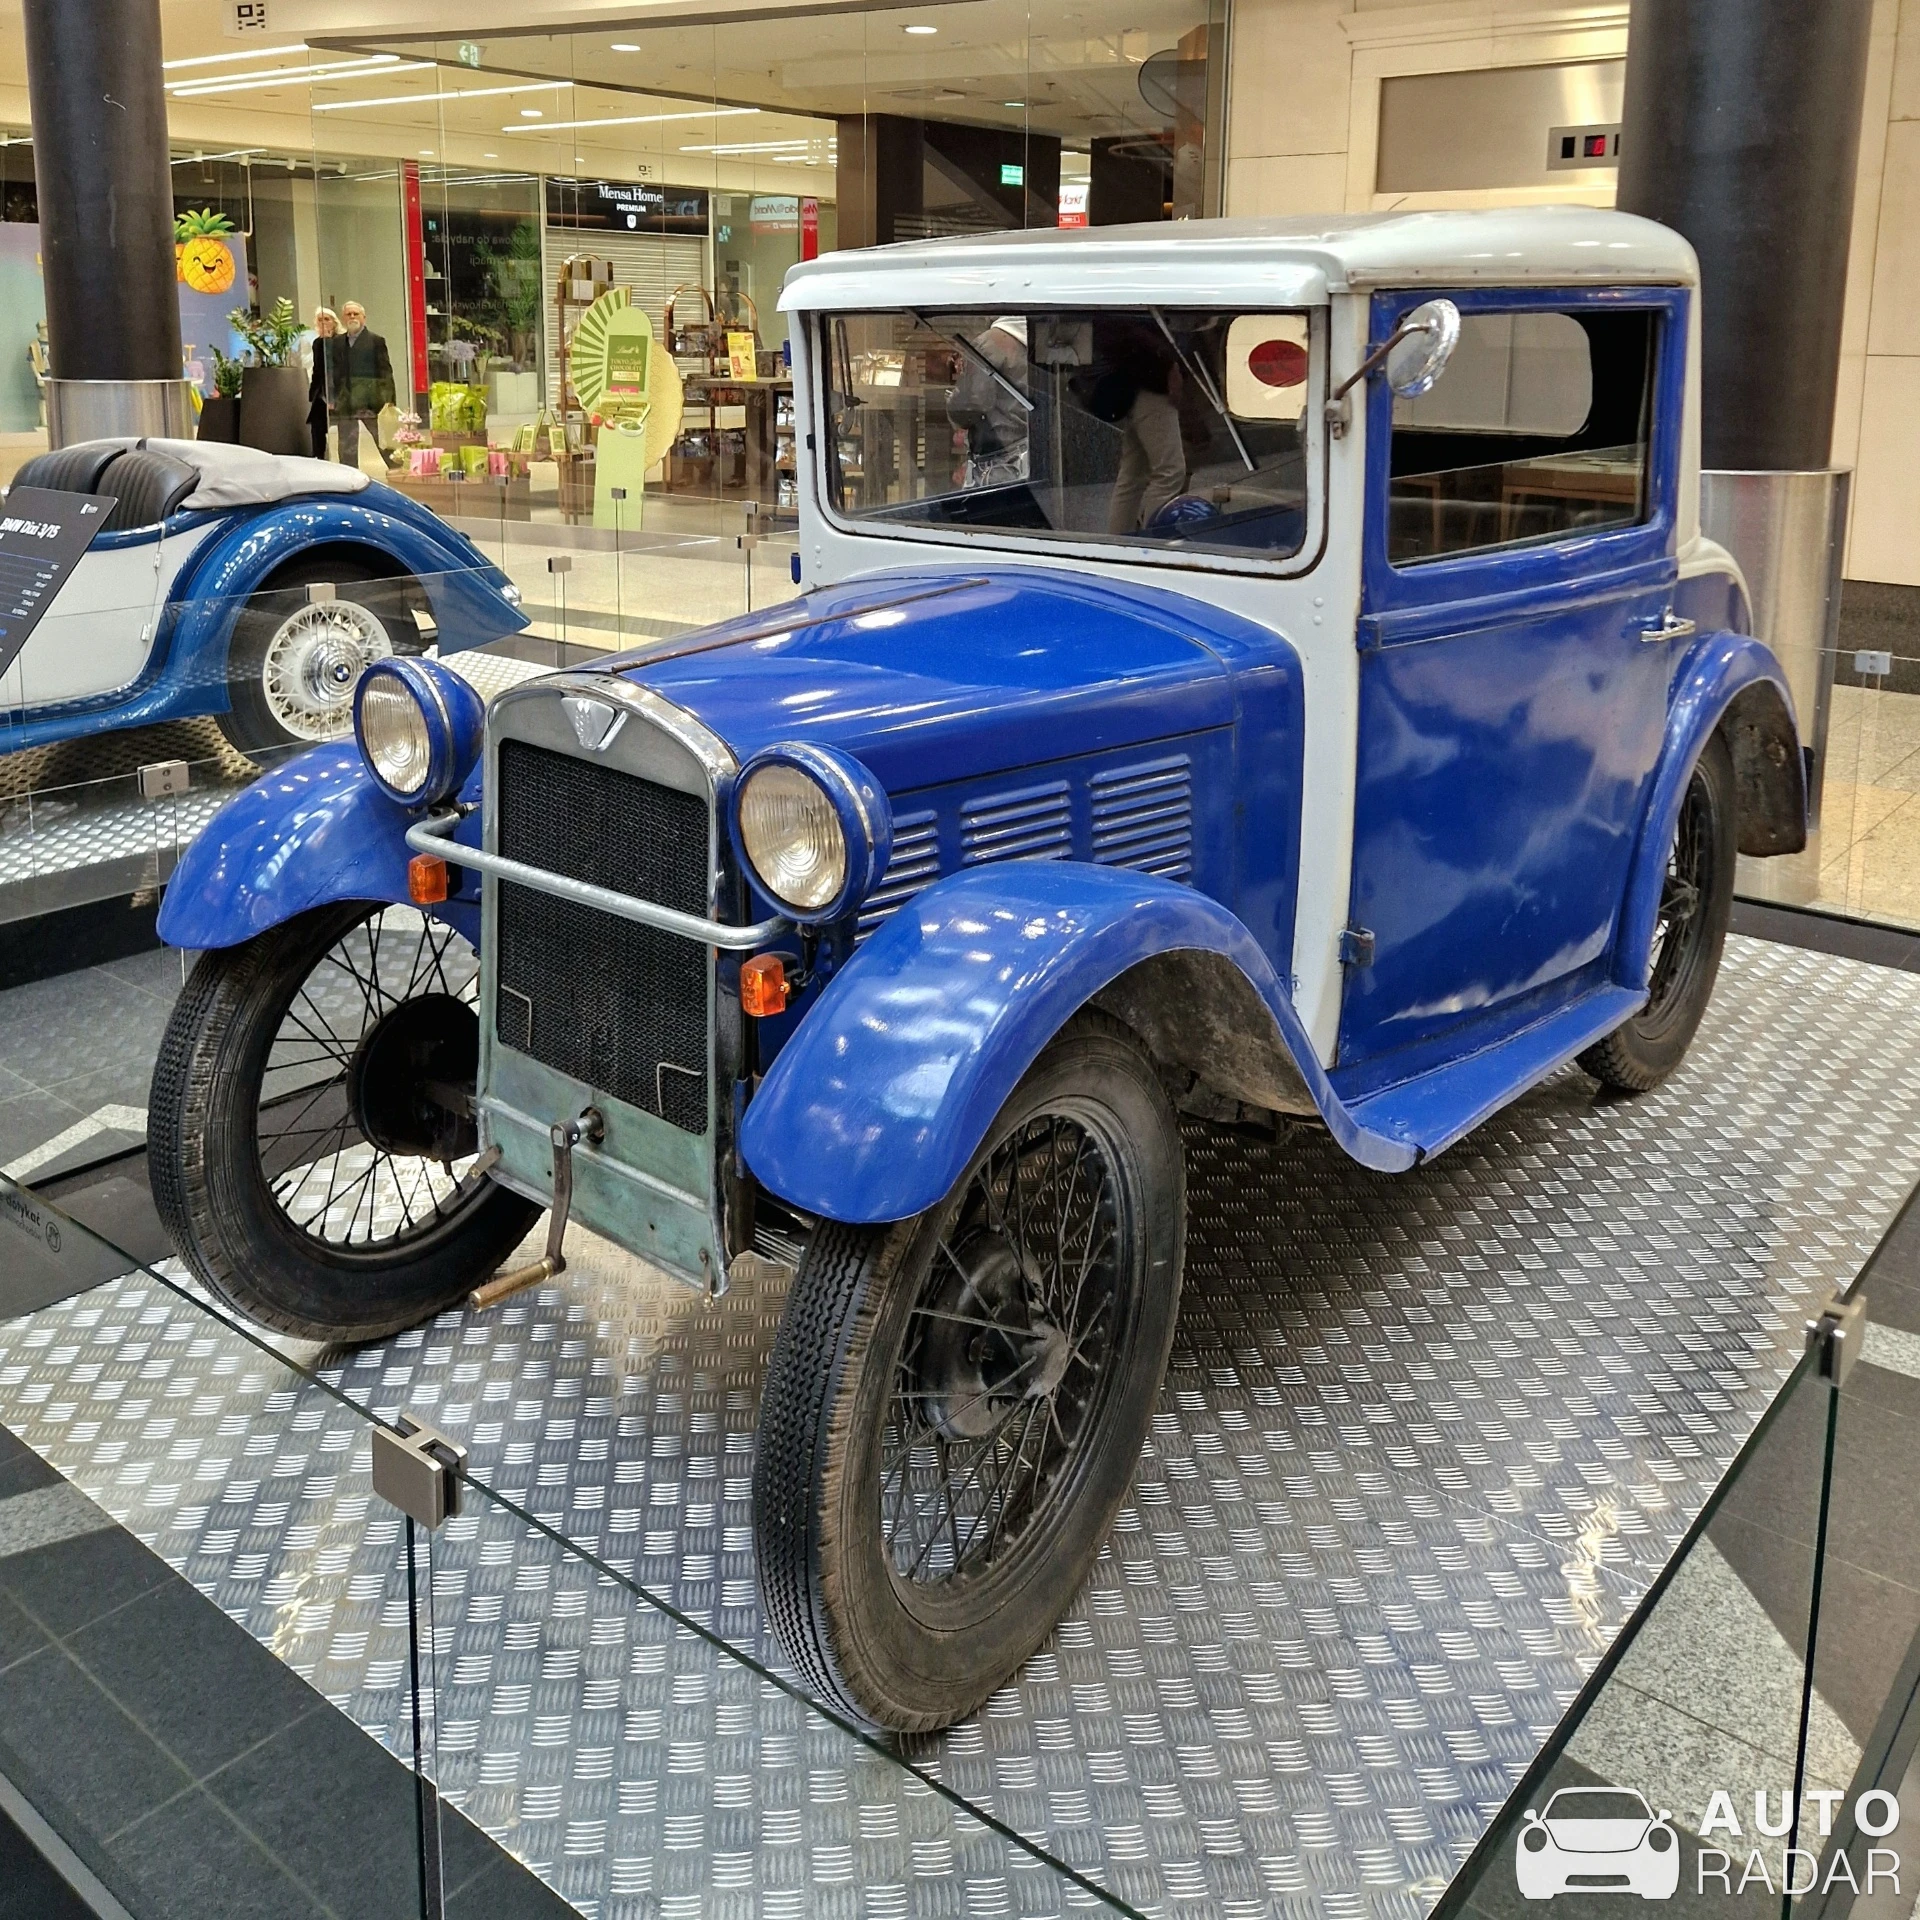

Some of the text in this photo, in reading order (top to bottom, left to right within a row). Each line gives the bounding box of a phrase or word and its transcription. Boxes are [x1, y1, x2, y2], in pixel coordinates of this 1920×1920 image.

[598, 185, 664, 203] Mensa Home
[616, 203, 647, 213] PREMIUM
[0, 517, 25, 532] BMW
[20, 520, 42, 536] Dixi
[37, 523, 62, 539] 3/15
